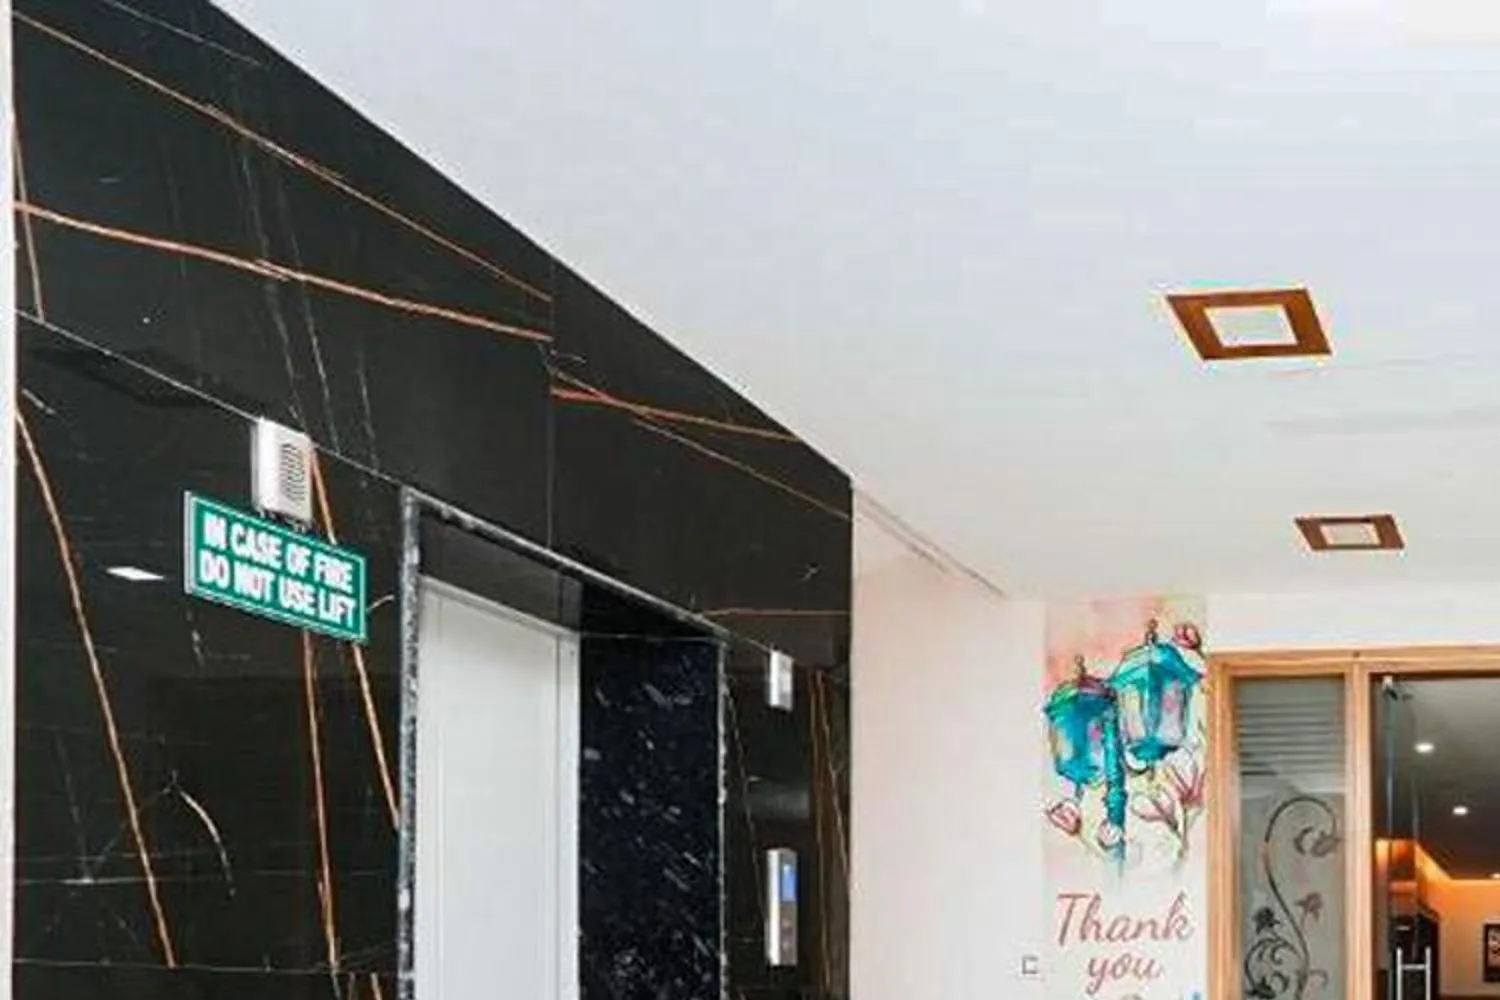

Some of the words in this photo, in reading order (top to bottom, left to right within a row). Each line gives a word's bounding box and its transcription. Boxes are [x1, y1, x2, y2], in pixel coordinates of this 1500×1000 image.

[203, 511, 228, 551] IN
[231, 520, 282, 570] CASE
[285, 541, 311, 577] OF
[314, 550, 353, 592] FIRE
[199, 550, 229, 589] DO
[233, 557, 275, 601] NOT
[277, 574, 316, 617] USE
[318, 593, 357, 627] LIFT
[1056, 890, 1196, 947] Thank
[1085, 952, 1165, 997] you
